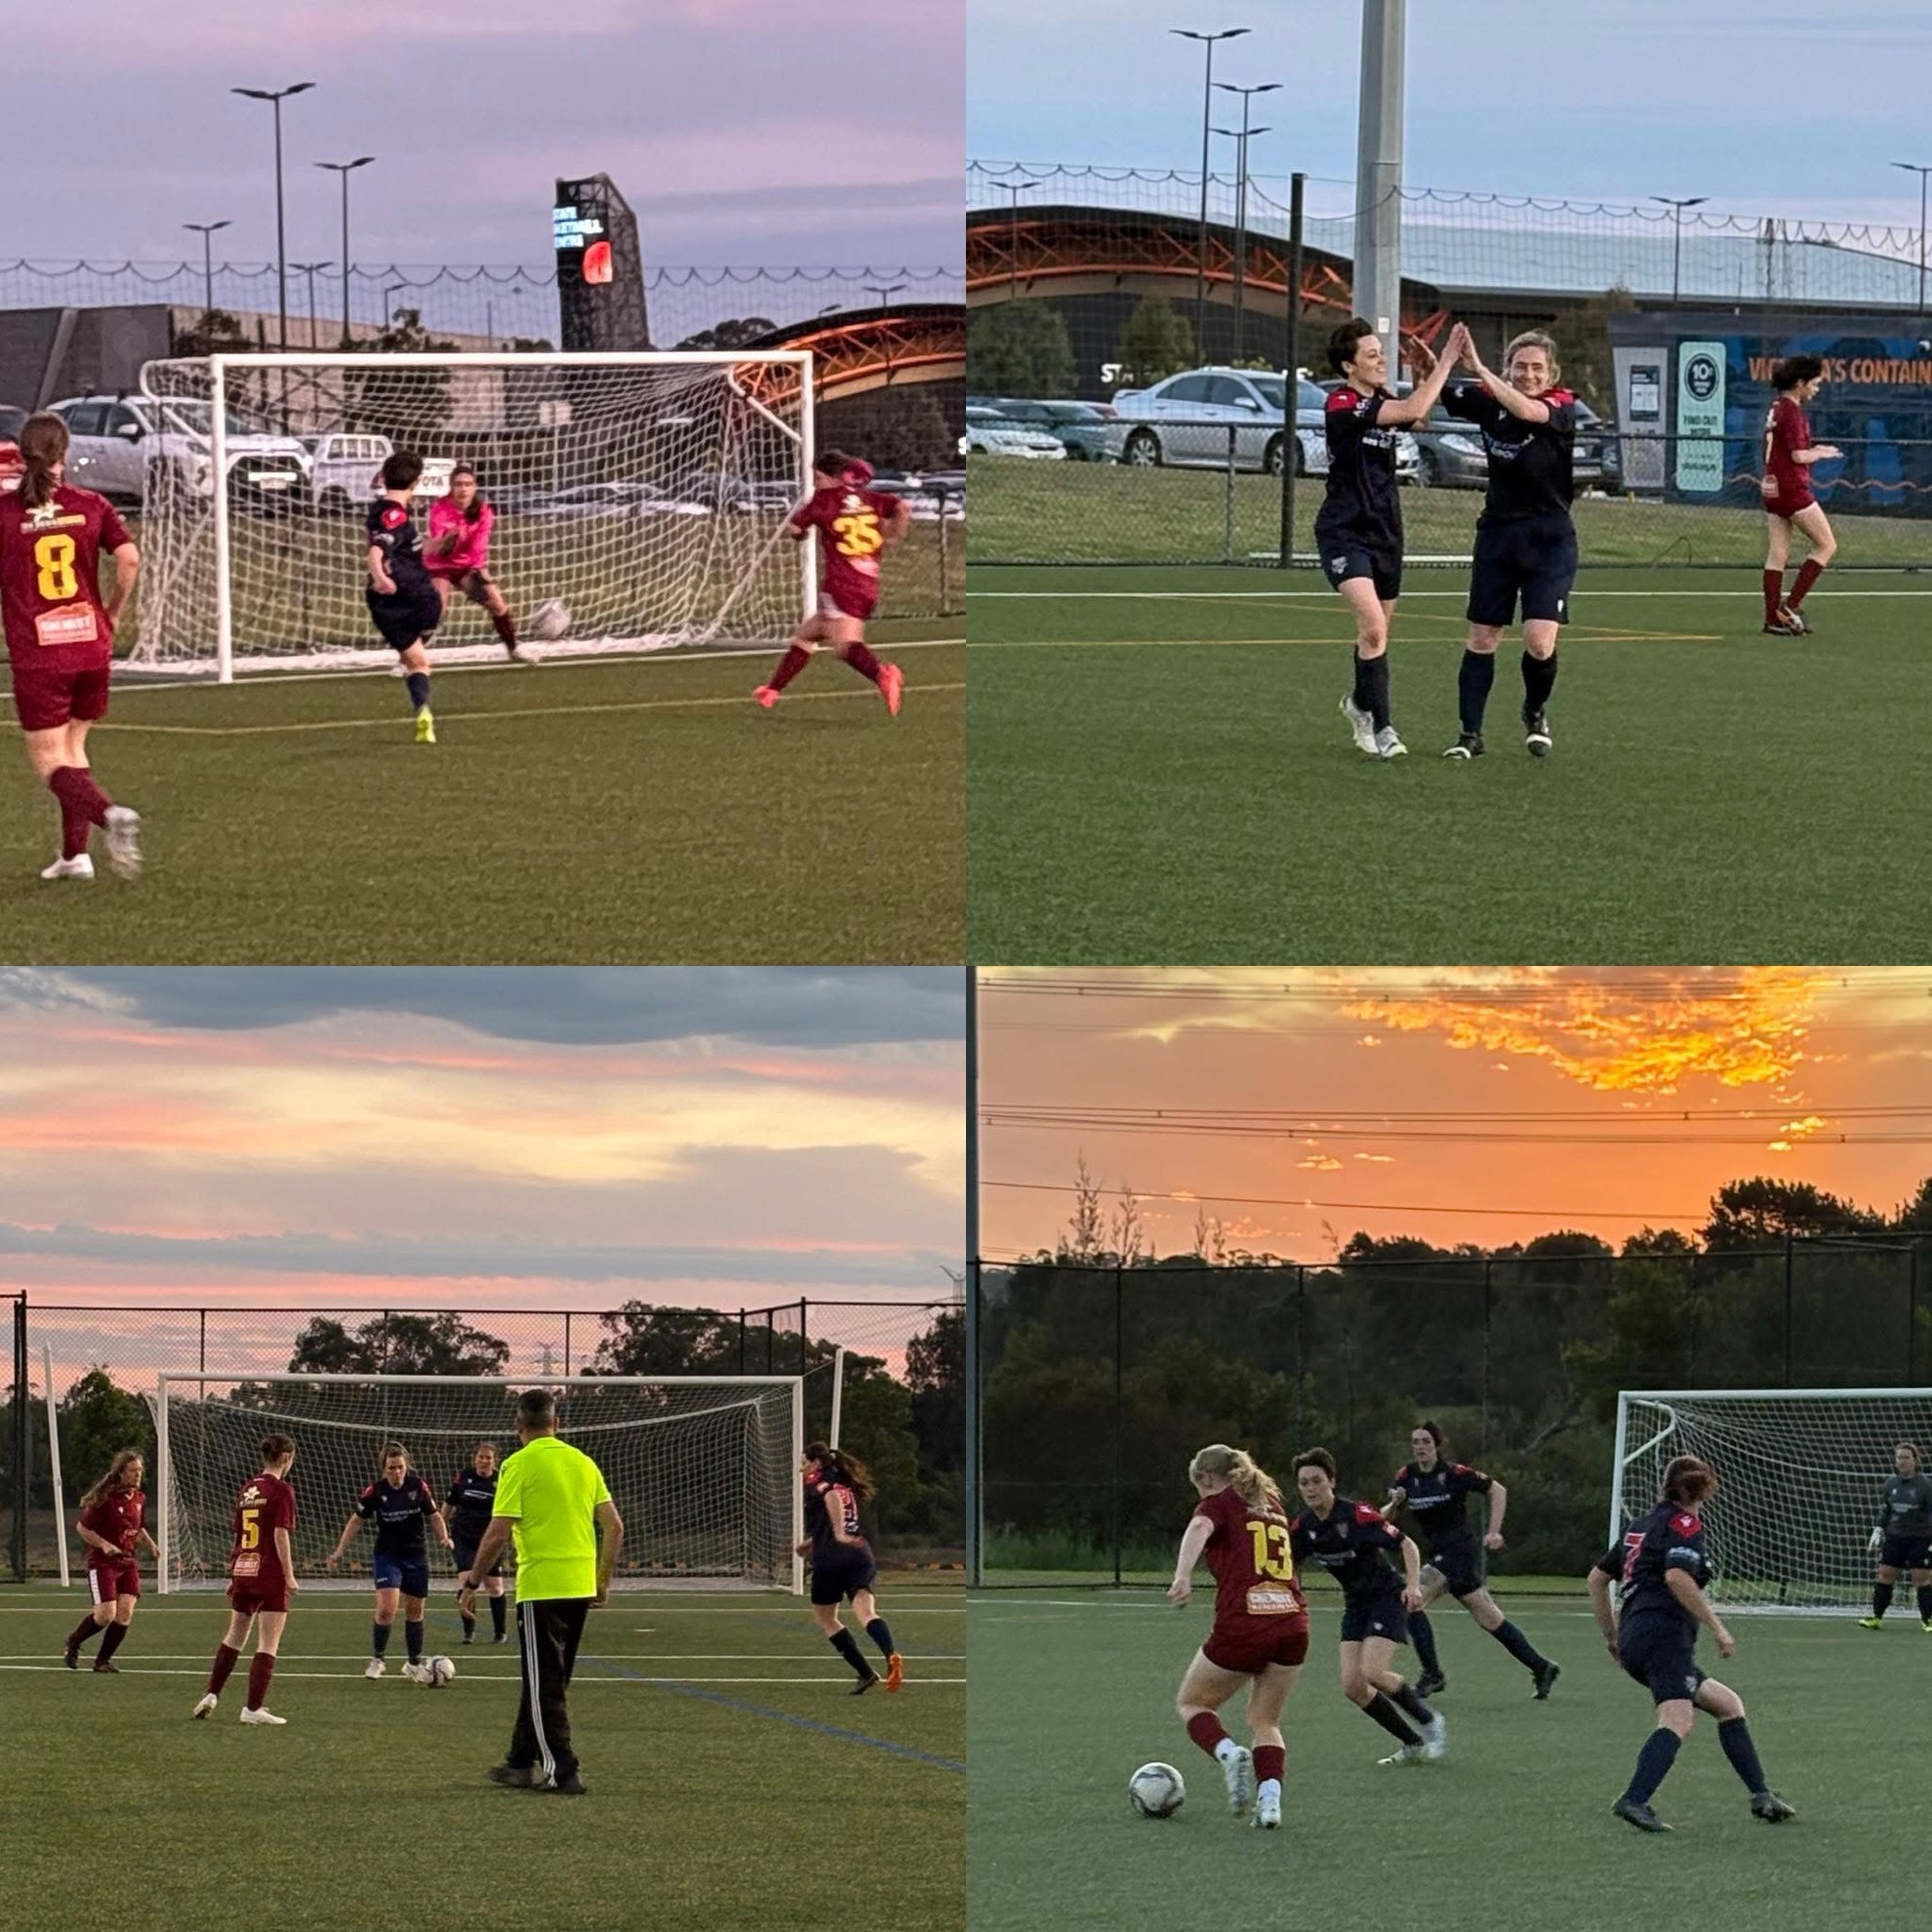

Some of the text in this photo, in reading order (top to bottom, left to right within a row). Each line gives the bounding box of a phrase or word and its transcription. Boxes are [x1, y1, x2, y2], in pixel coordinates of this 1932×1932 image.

[832, 514, 884, 556] 35
[35, 533, 79, 601] 8
[241, 1509, 260, 1549] 5
[1245, 1520, 1293, 1580] 13
[1622, 1532, 1646, 1587] 7
